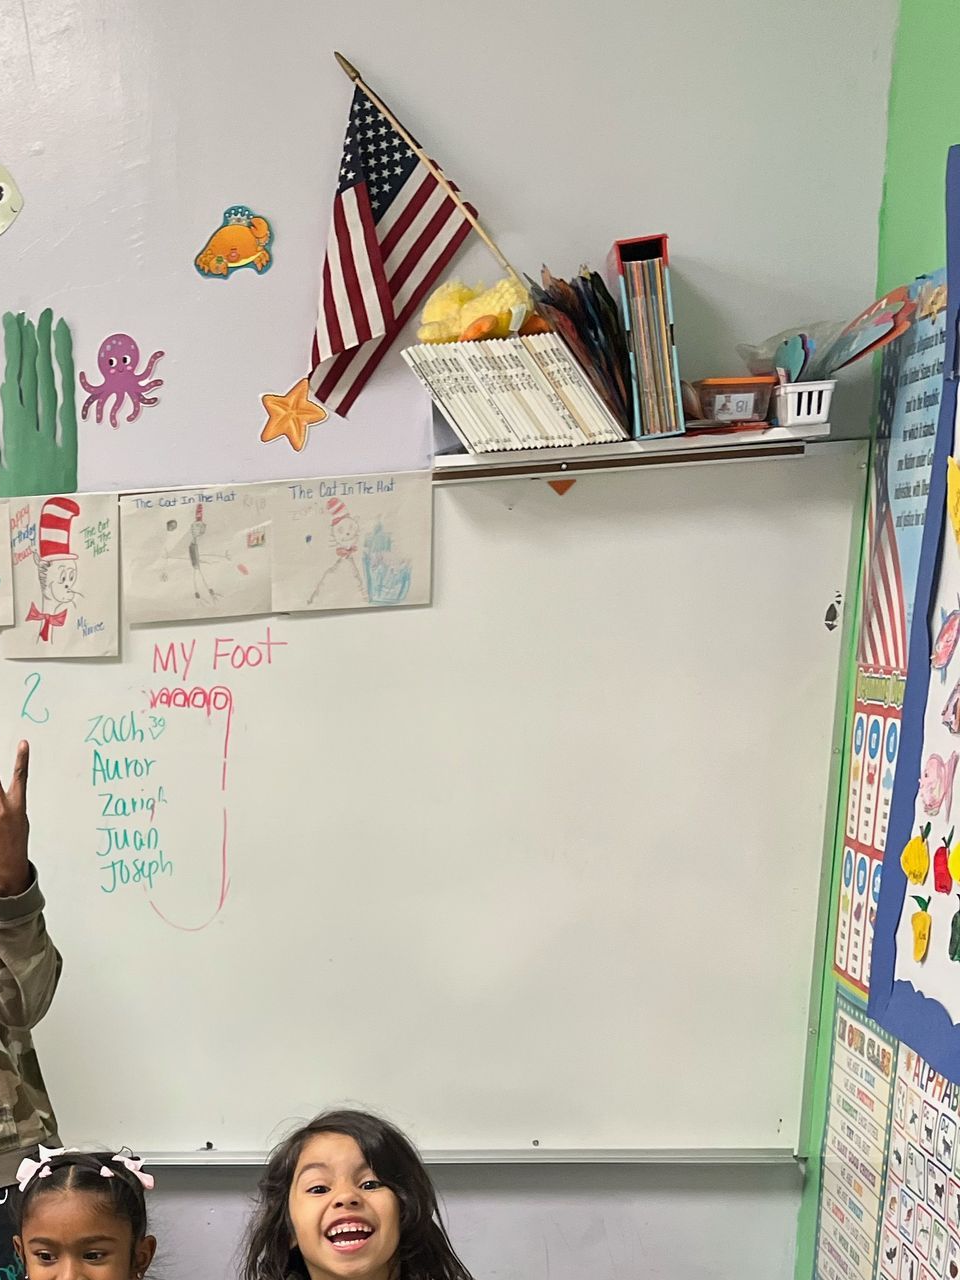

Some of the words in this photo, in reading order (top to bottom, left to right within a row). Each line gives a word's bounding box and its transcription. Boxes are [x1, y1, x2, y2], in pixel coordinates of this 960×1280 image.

[133, 498, 153, 509] The
[159, 496, 177, 508] Cat
[181, 494, 195, 506] In
[196, 492, 214, 503] The
[216, 490, 237, 502] Hat
[288, 485, 313, 500] The
[319, 481, 337, 498] Cat
[341, 481, 354, 495] In
[357, 480, 374, 494] The
[377, 480, 396, 493] Hat
[10, 504, 30, 530] appy
[80, 526, 96, 538] The
[21, 672, 49, 723] 2
[84, 711, 144, 746] Zach
[92, 749, 156, 786] Auror
[96, 826, 158, 857] Juan
[100, 850, 173, 893] Joseph
[912, 1054, 960, 1118] ALPHAB
